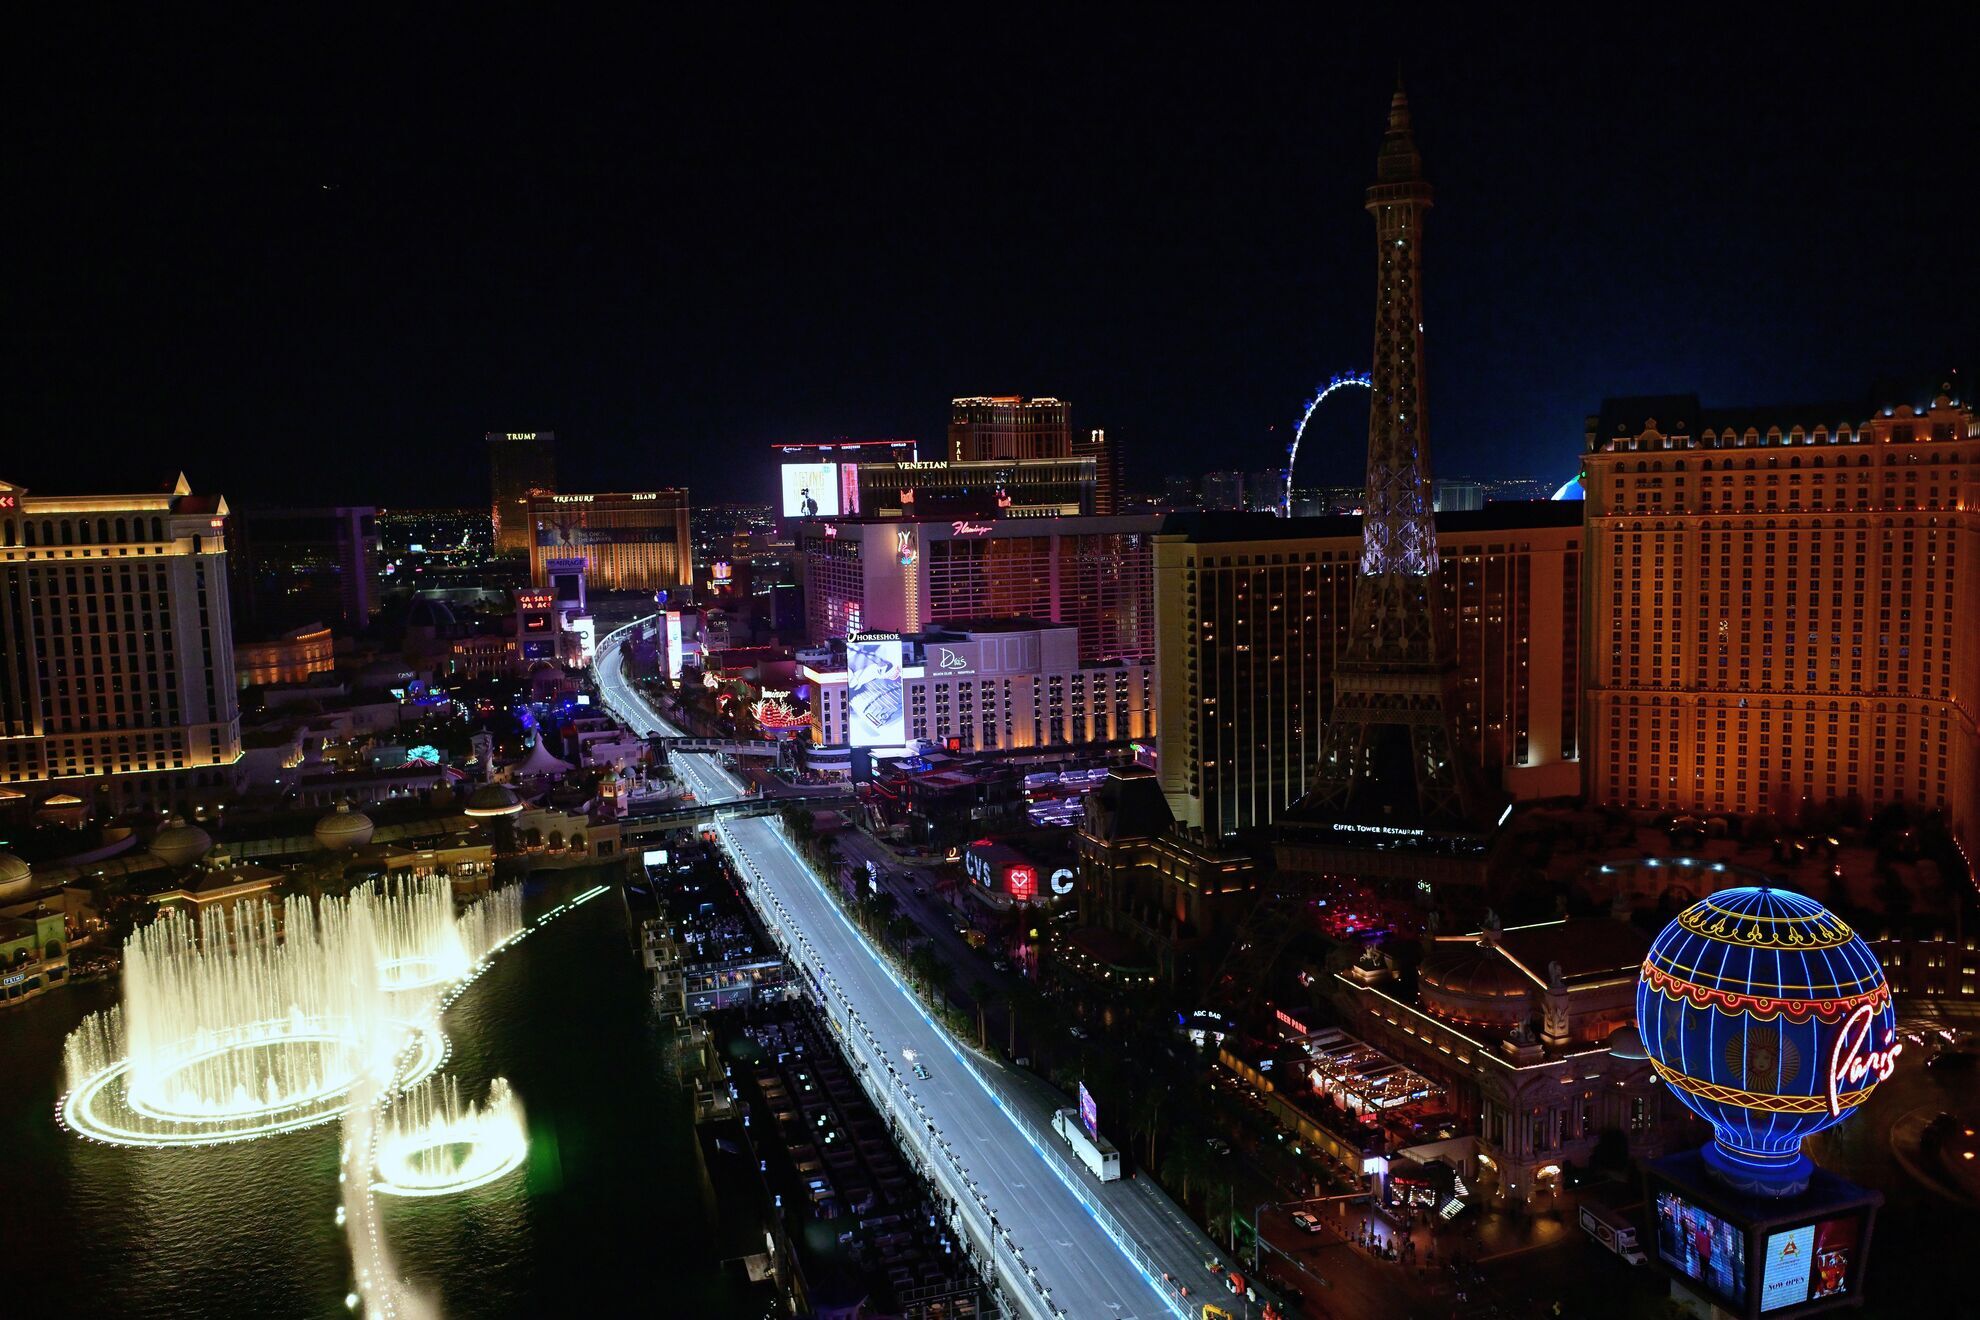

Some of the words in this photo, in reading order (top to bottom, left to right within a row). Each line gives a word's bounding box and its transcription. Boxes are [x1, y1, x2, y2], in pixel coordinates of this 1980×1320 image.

[506, 432, 537, 441] TRUMP
[897, 461, 948, 470] VENETIAN
[552, 495, 594, 503] TREASURE
[632, 493, 657, 501] ISLAND
[951, 521, 993, 536] Flamingo
[856, 633, 900, 641] HORSESHOE
[1333, 823, 1355, 832] EIFFEL
[1356, 824, 1381, 833] TOWER
[1382, 826, 1424, 836] RESTAURANT
[965, 850, 992, 888] CVS
[1208, 1010, 1222, 1020] BAR
[1276, 1009, 1291, 1025] BEER
[1291, 1018, 1307, 1035] PARK
[1825, 1004, 1902, 1117] Paris
[1768, 1281, 1784, 1291] NOW
[1785, 1276, 1806, 1288] OPEN
